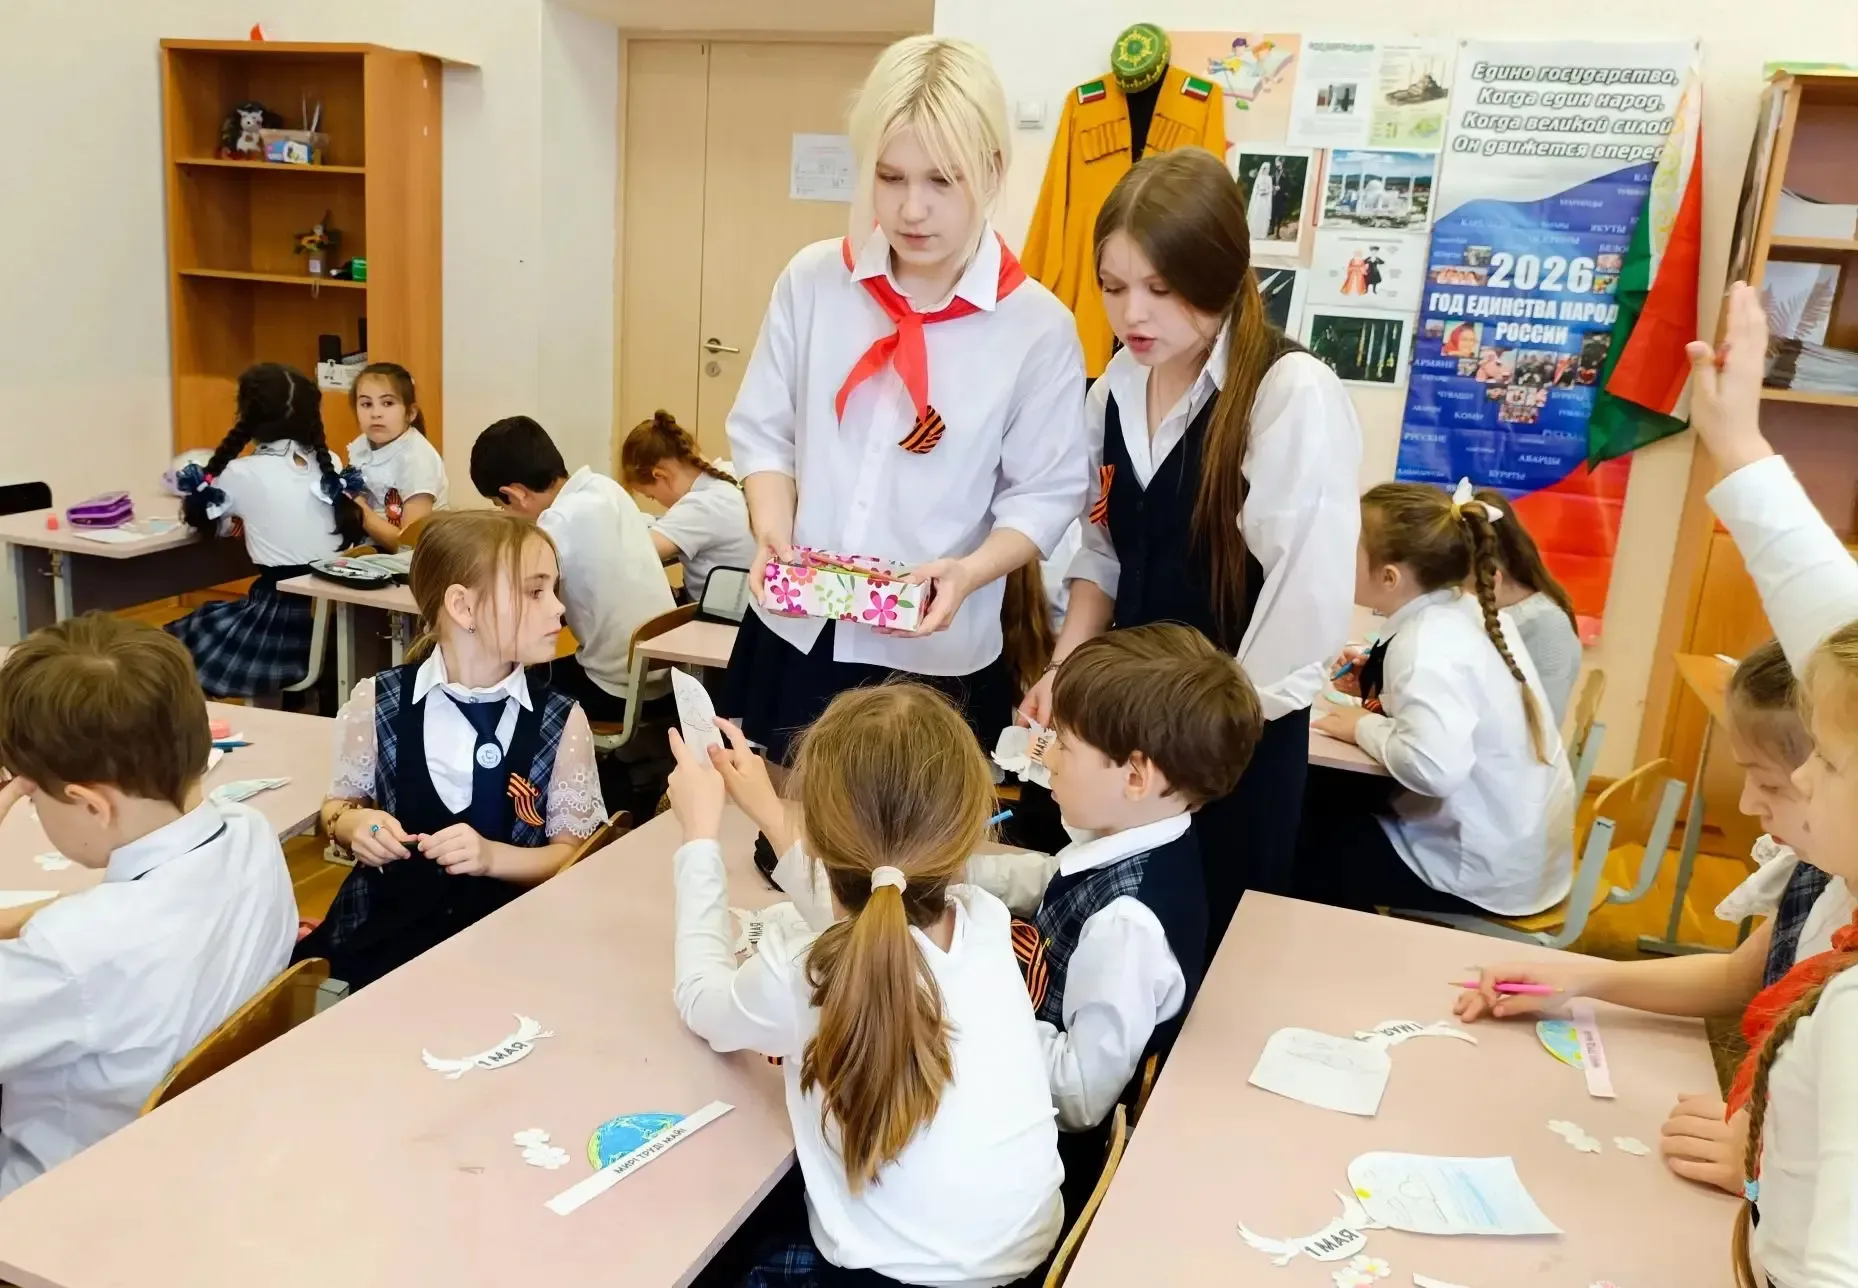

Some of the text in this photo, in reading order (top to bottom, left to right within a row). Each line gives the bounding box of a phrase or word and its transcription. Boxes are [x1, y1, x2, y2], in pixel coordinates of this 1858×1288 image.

[1472, 61, 1535, 82] Едино
[1477, 87, 1539, 108] Когда
[1541, 91, 1593, 109] един
[1462, 111, 1674, 135] Когда великой силой
[1453, 135, 1481, 153] Он
[1483, 138, 1589, 157] движется
[1487, 252, 1595, 294] 2026
[1429, 293, 1620, 325] ГОД ЕДИНСТВА НАРОД
[1495, 322, 1569, 345] РОССИИ
[1031, 736, 1049, 756] МАЯ
[1379, 1023, 1416, 1037] МАЯ
[488, 1041, 528, 1062] МАЯ
[1304, 1228, 1360, 1257] 1 МАЯ
